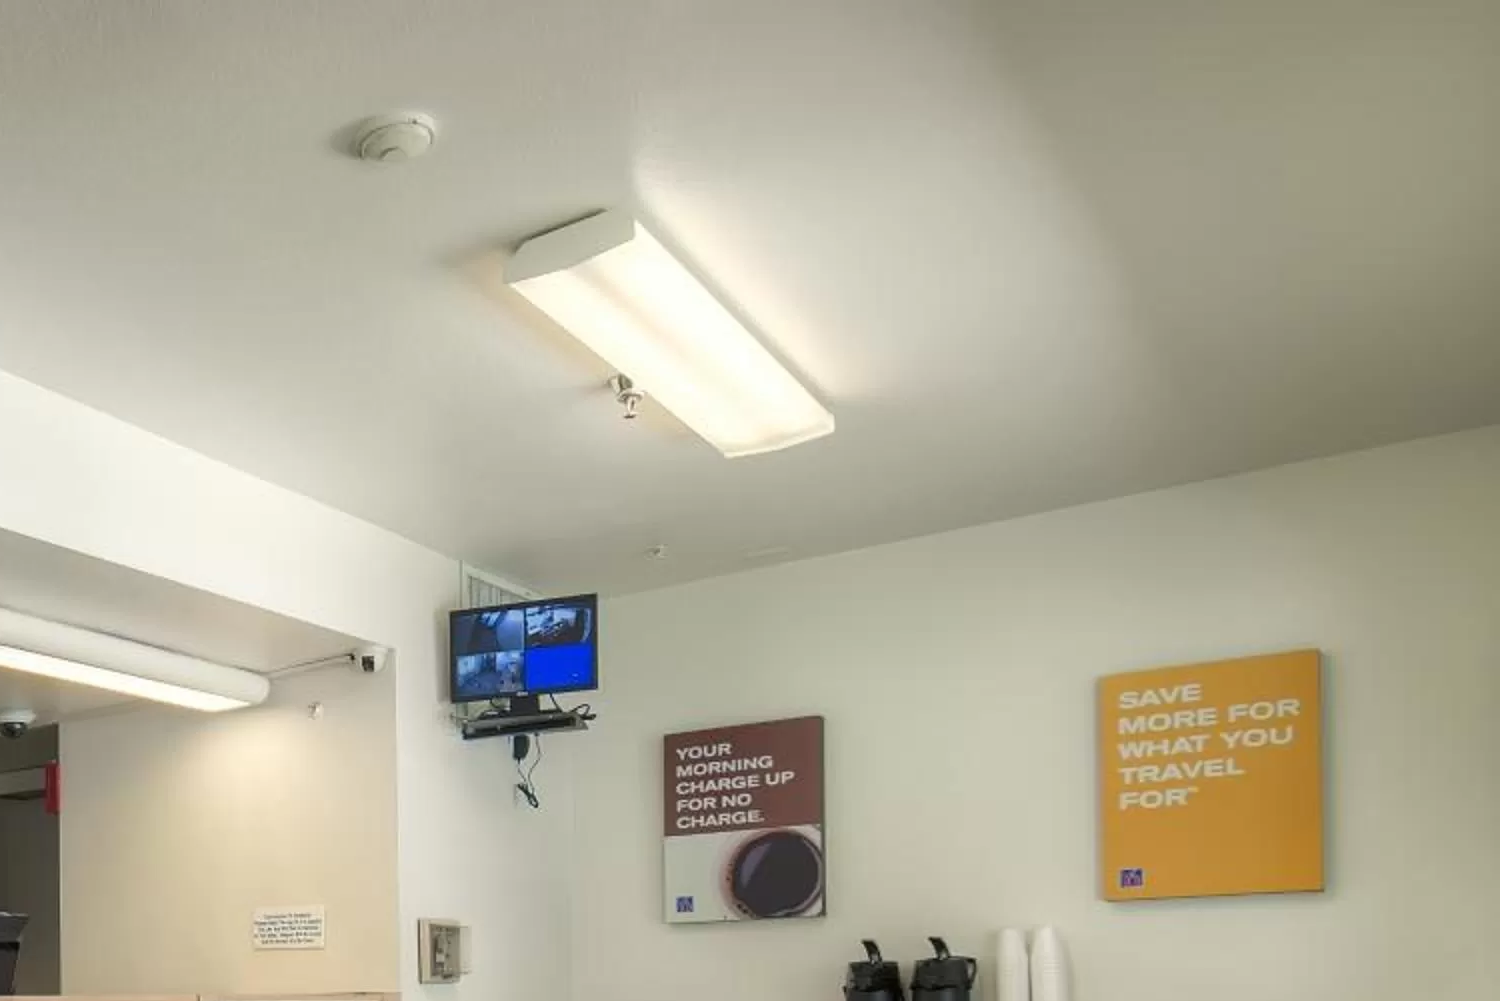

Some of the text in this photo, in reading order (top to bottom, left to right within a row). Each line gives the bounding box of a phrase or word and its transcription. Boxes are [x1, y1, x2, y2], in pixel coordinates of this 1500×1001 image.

[1119, 683, 1202, 709] SAVE
[1118, 699, 1301, 734] MORE FOR
[675, 743, 732, 760] YOUR
[1117, 726, 1293, 760] WHAT YOU
[675, 755, 773, 777] MORNING
[1118, 757, 1245, 785] TRAVEL
[675, 771, 795, 795] CHARGE UP
[675, 793, 752, 812] FOR NO
[675, 810, 765, 829] CHARGE.
